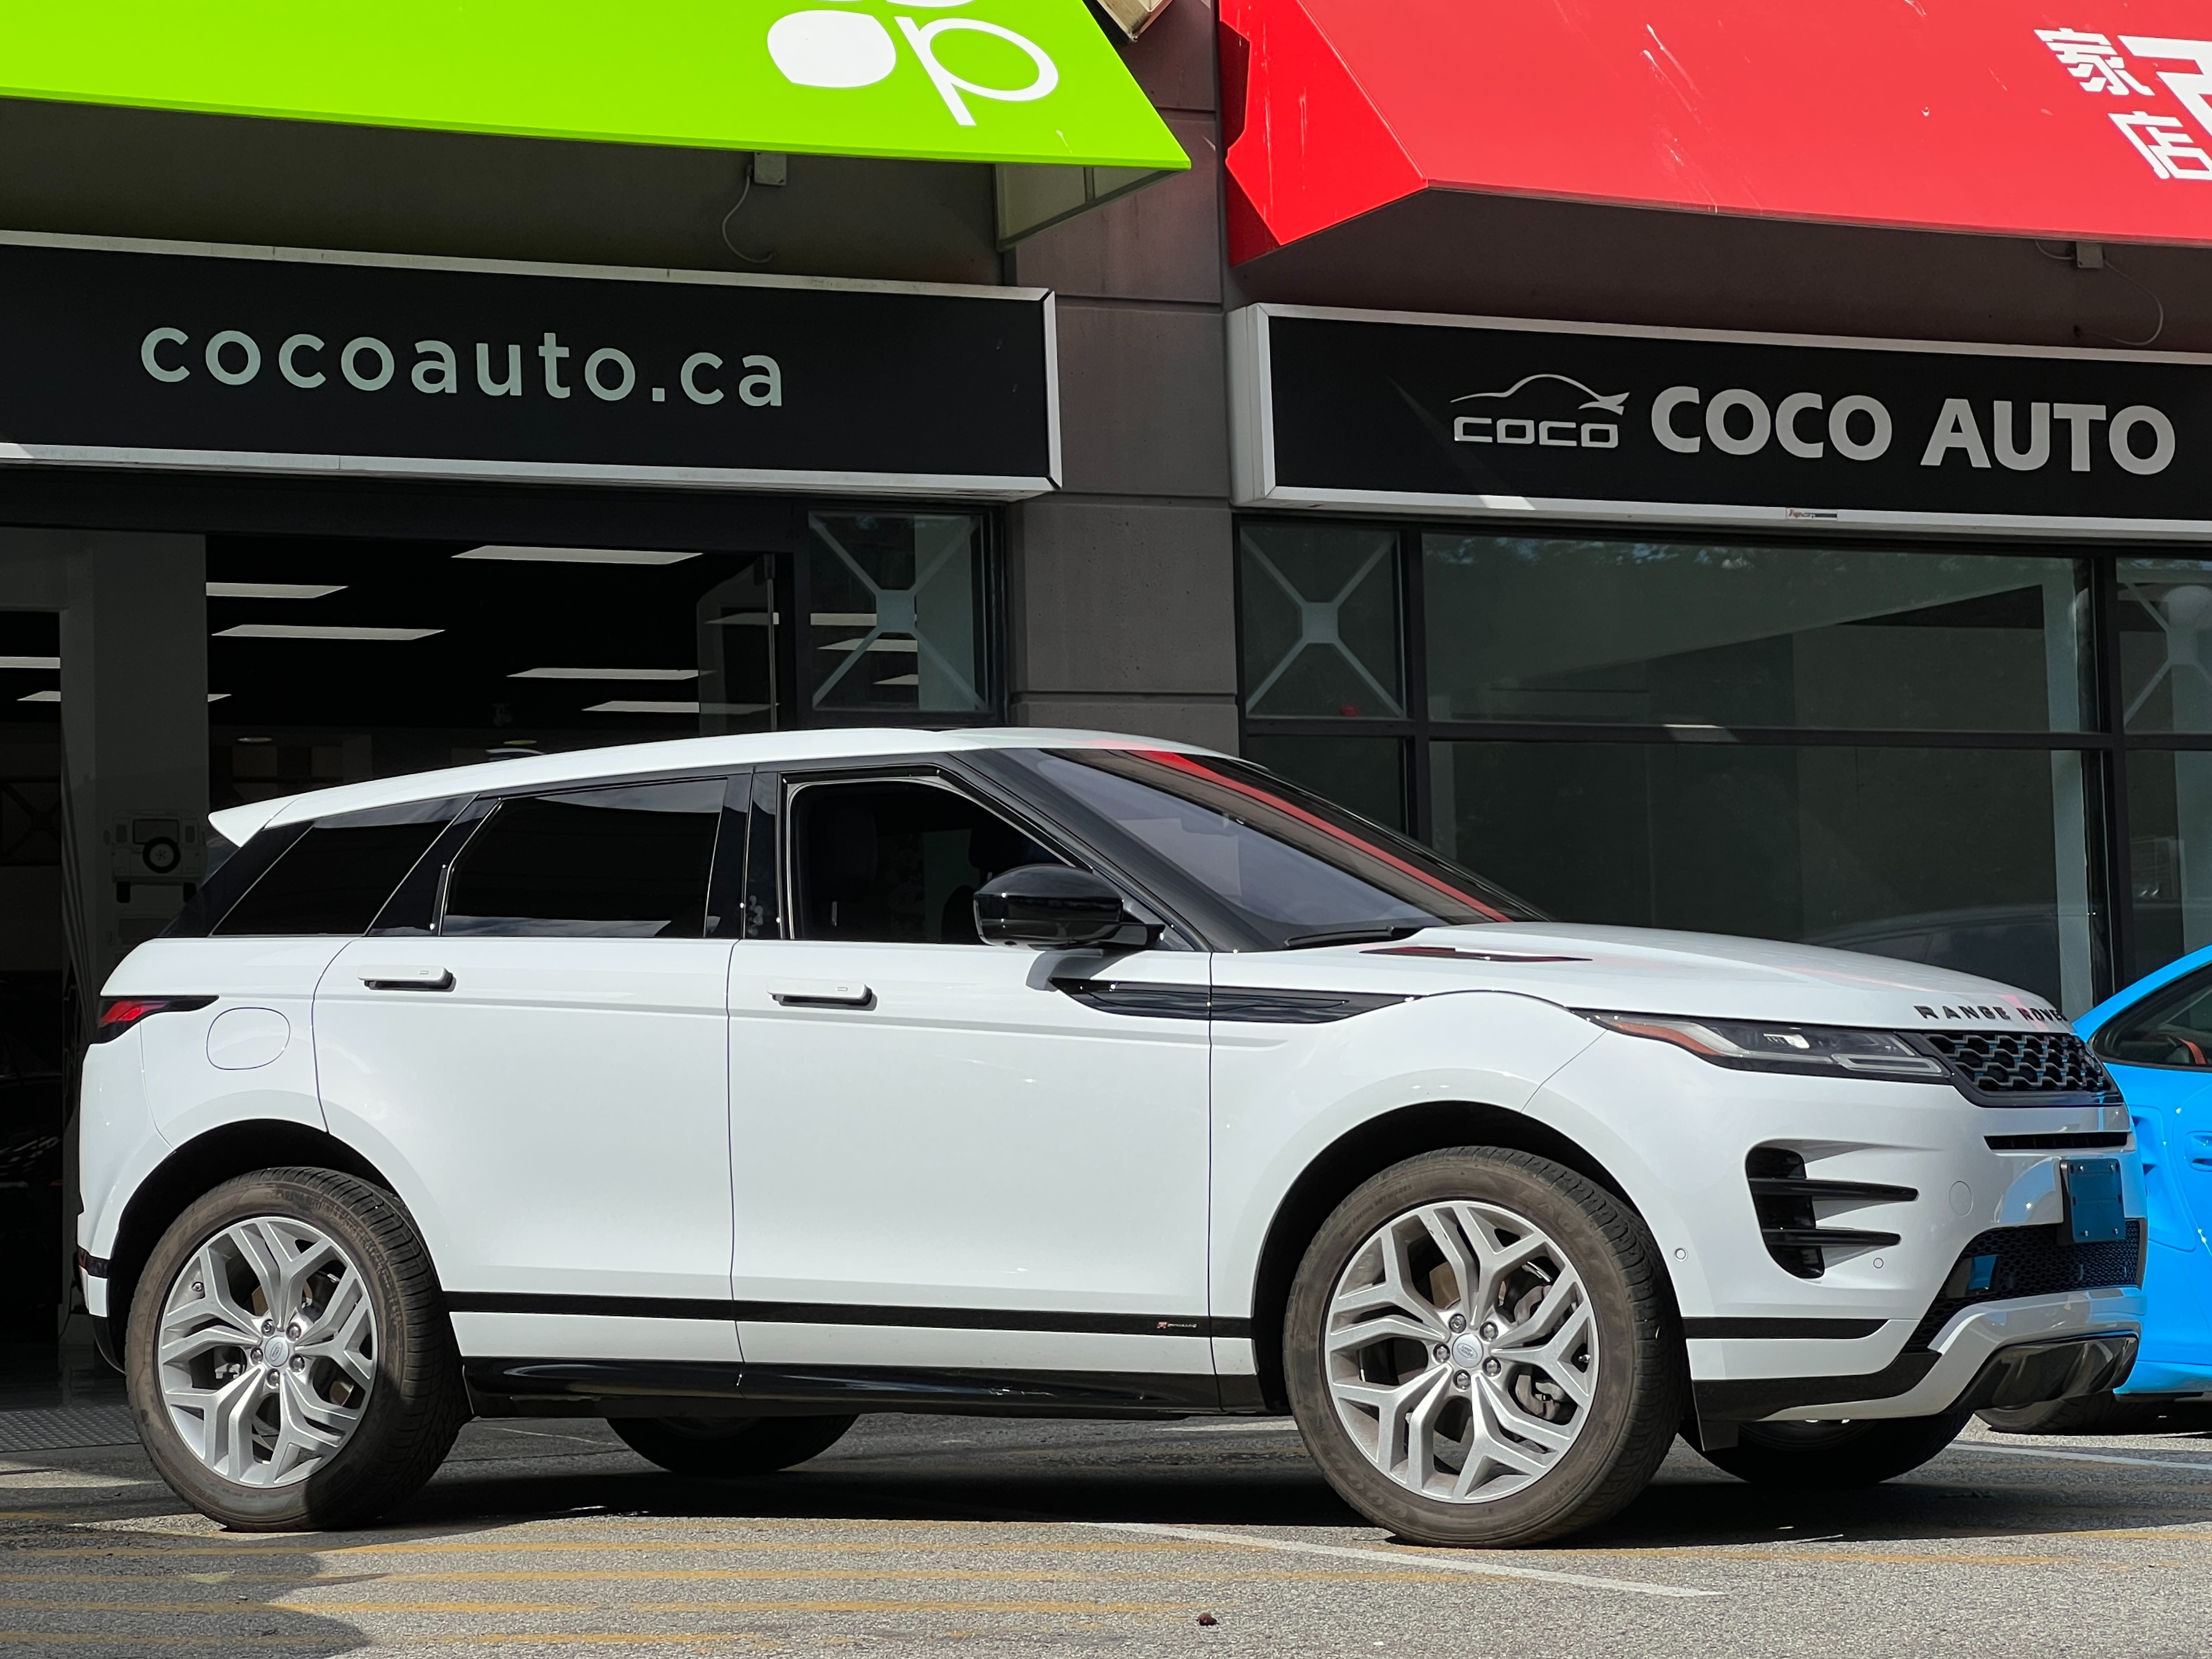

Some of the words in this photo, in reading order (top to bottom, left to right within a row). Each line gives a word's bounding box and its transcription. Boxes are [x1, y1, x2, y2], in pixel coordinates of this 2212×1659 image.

[141, 327, 782, 407] cocoauto.ca
[1454, 416, 1619, 449] COCO
[1651, 386, 1892, 461] COCO
[1920, 398, 2176, 475] AUTO
[1913, 1005, 2011, 1021] RANGE
